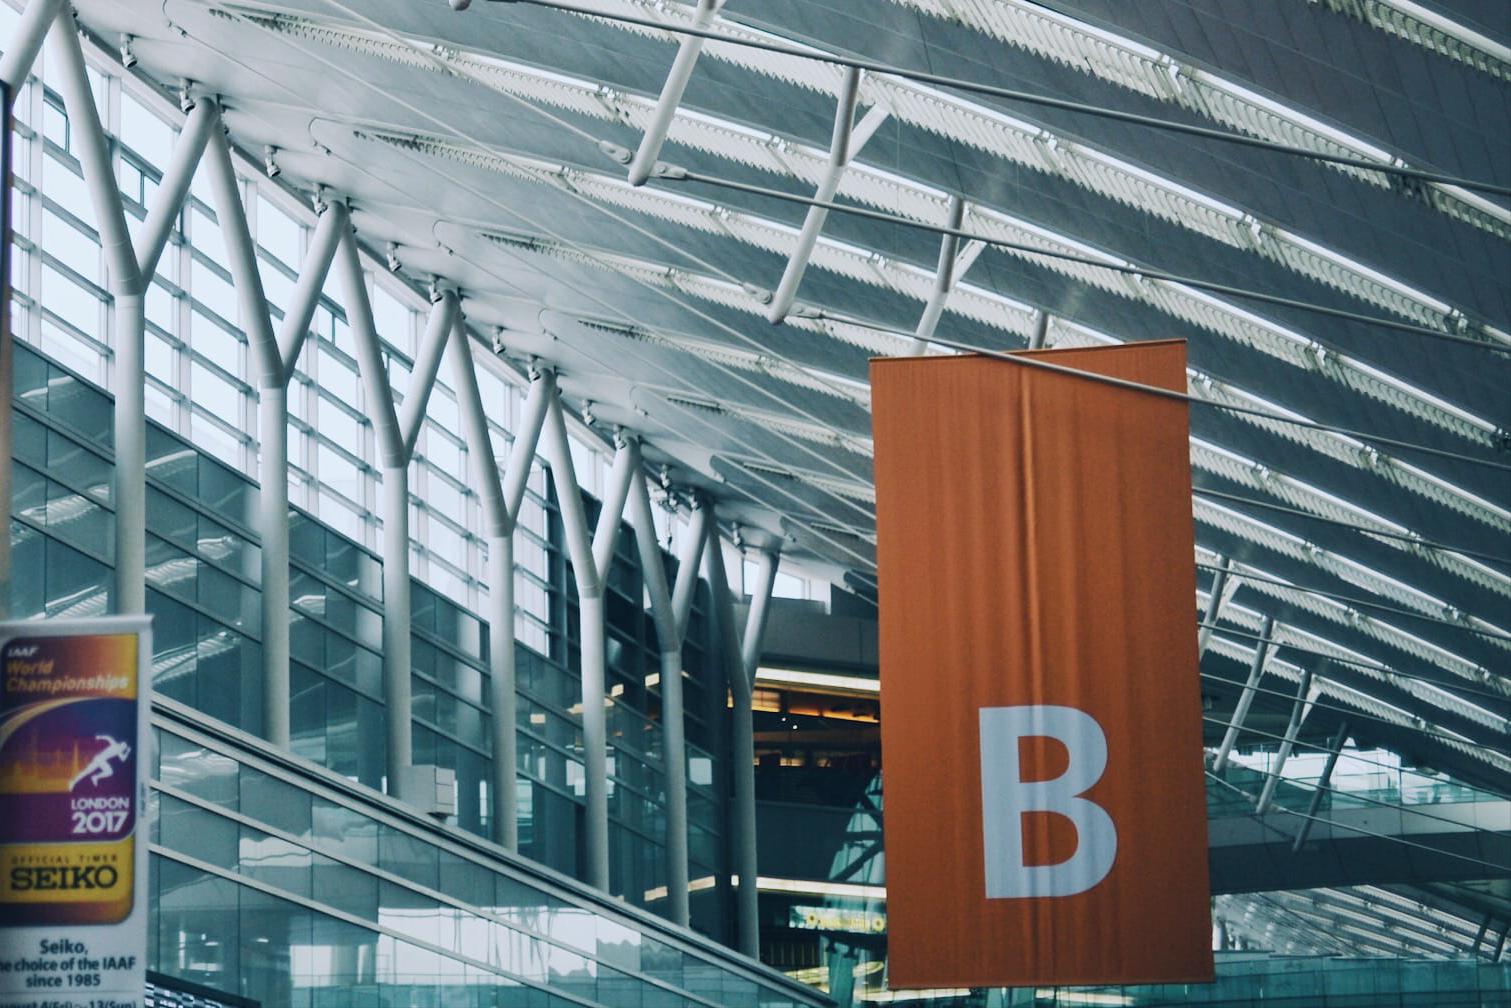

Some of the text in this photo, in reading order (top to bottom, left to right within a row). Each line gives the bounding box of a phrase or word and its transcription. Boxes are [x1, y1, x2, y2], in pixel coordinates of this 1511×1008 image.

[7, 659, 54, 674] World
[7, 673, 129, 694] Championships
[71, 798, 130, 810] LONDON
[979, 705, 1118, 899] B
[72, 811, 130, 833] 2017
[10, 866, 118, 891] SEIKO
[40, 939, 89, 955] Seiko,
[14, 958, 57, 971] choice
[60, 957, 75, 970] of
[78, 958, 99, 969] the
[103, 957, 137, 970] IAAF
[26, 974, 101, 987] since 1985
